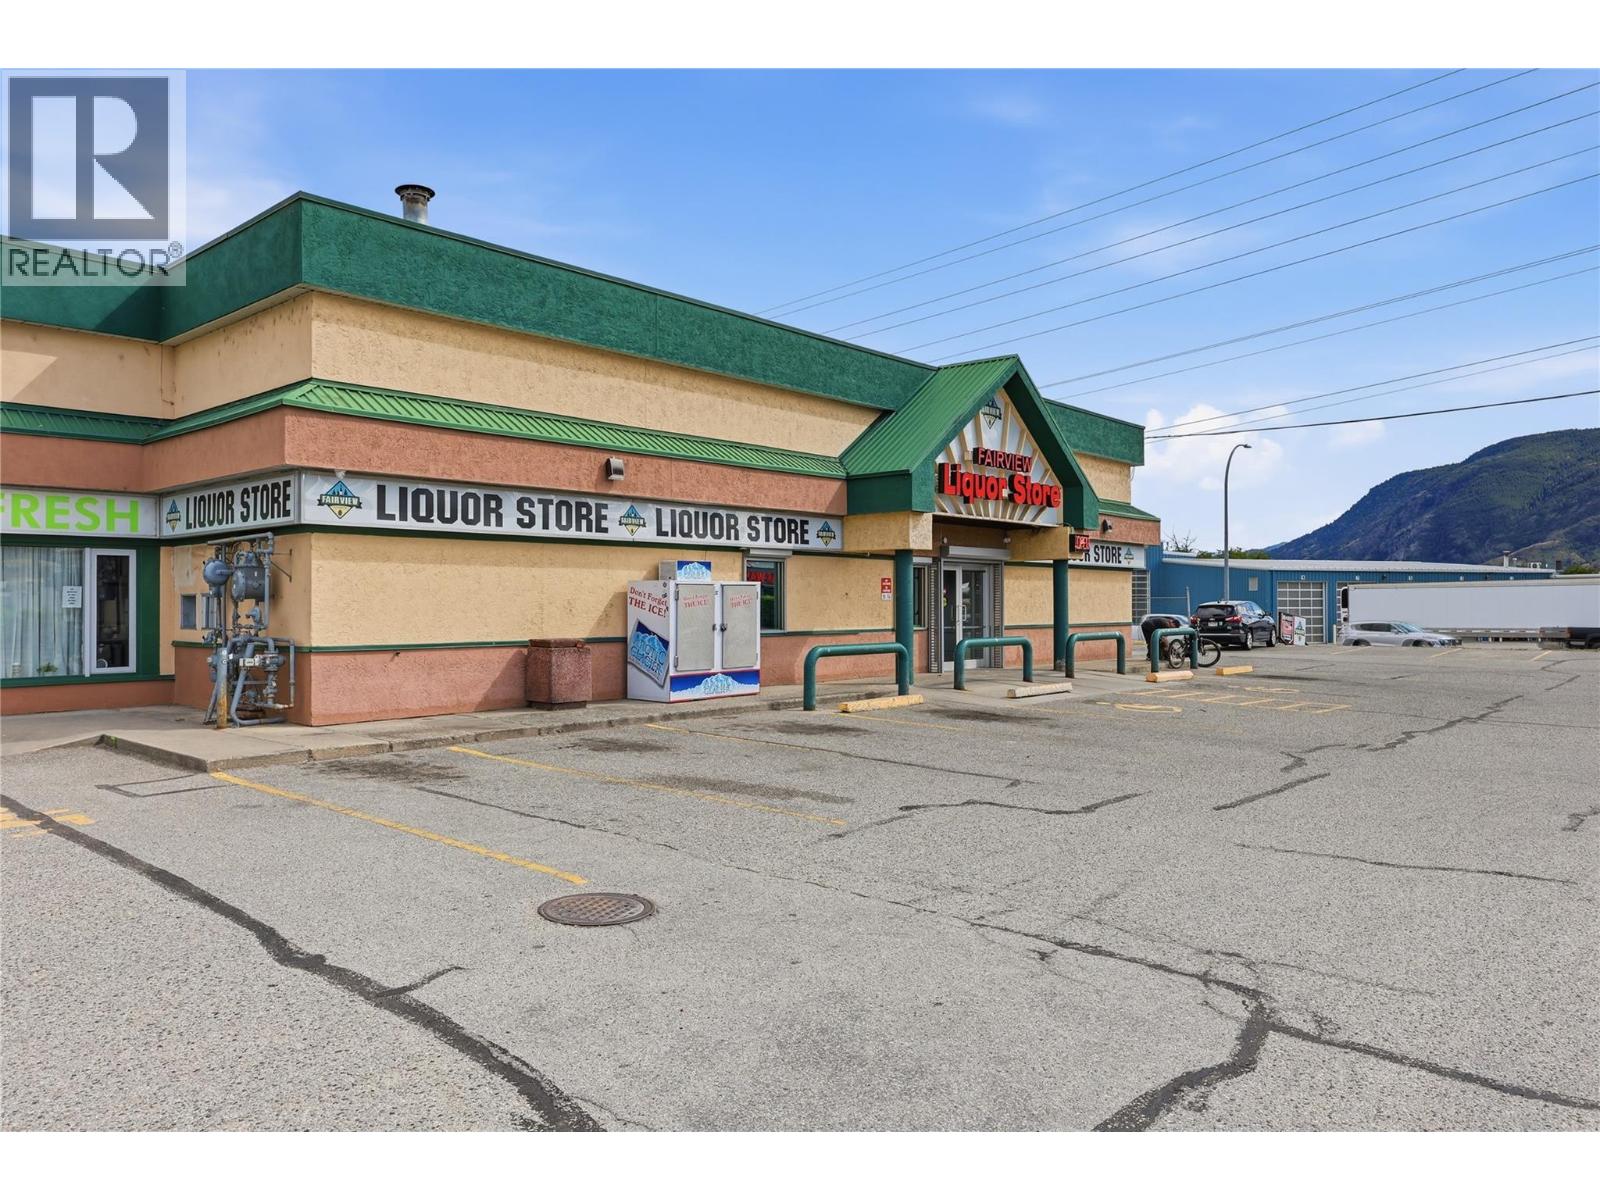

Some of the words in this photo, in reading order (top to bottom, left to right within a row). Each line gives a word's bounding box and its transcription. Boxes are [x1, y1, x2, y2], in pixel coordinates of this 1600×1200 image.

[978, 447, 1032, 472] FAIRVIEW
[943, 463, 1007, 504] Liquor
[1013, 473, 1061, 508] Store
[185, 489, 235, 530] LIQUOR
[240, 479, 292, 522] STORE
[321, 494, 359, 507] FAIRVIEW
[376, 484, 503, 528] LIQUOR
[516, 496, 609, 534] STORE
[656, 507, 740, 541] LIQUOR
[747, 515, 810, 545] STORE
[1093, 544, 1122, 564] STORE
[630, 586, 646, 599] Don't
[629, 596, 647, 611] THE
[648, 603, 668, 619] ICE!
